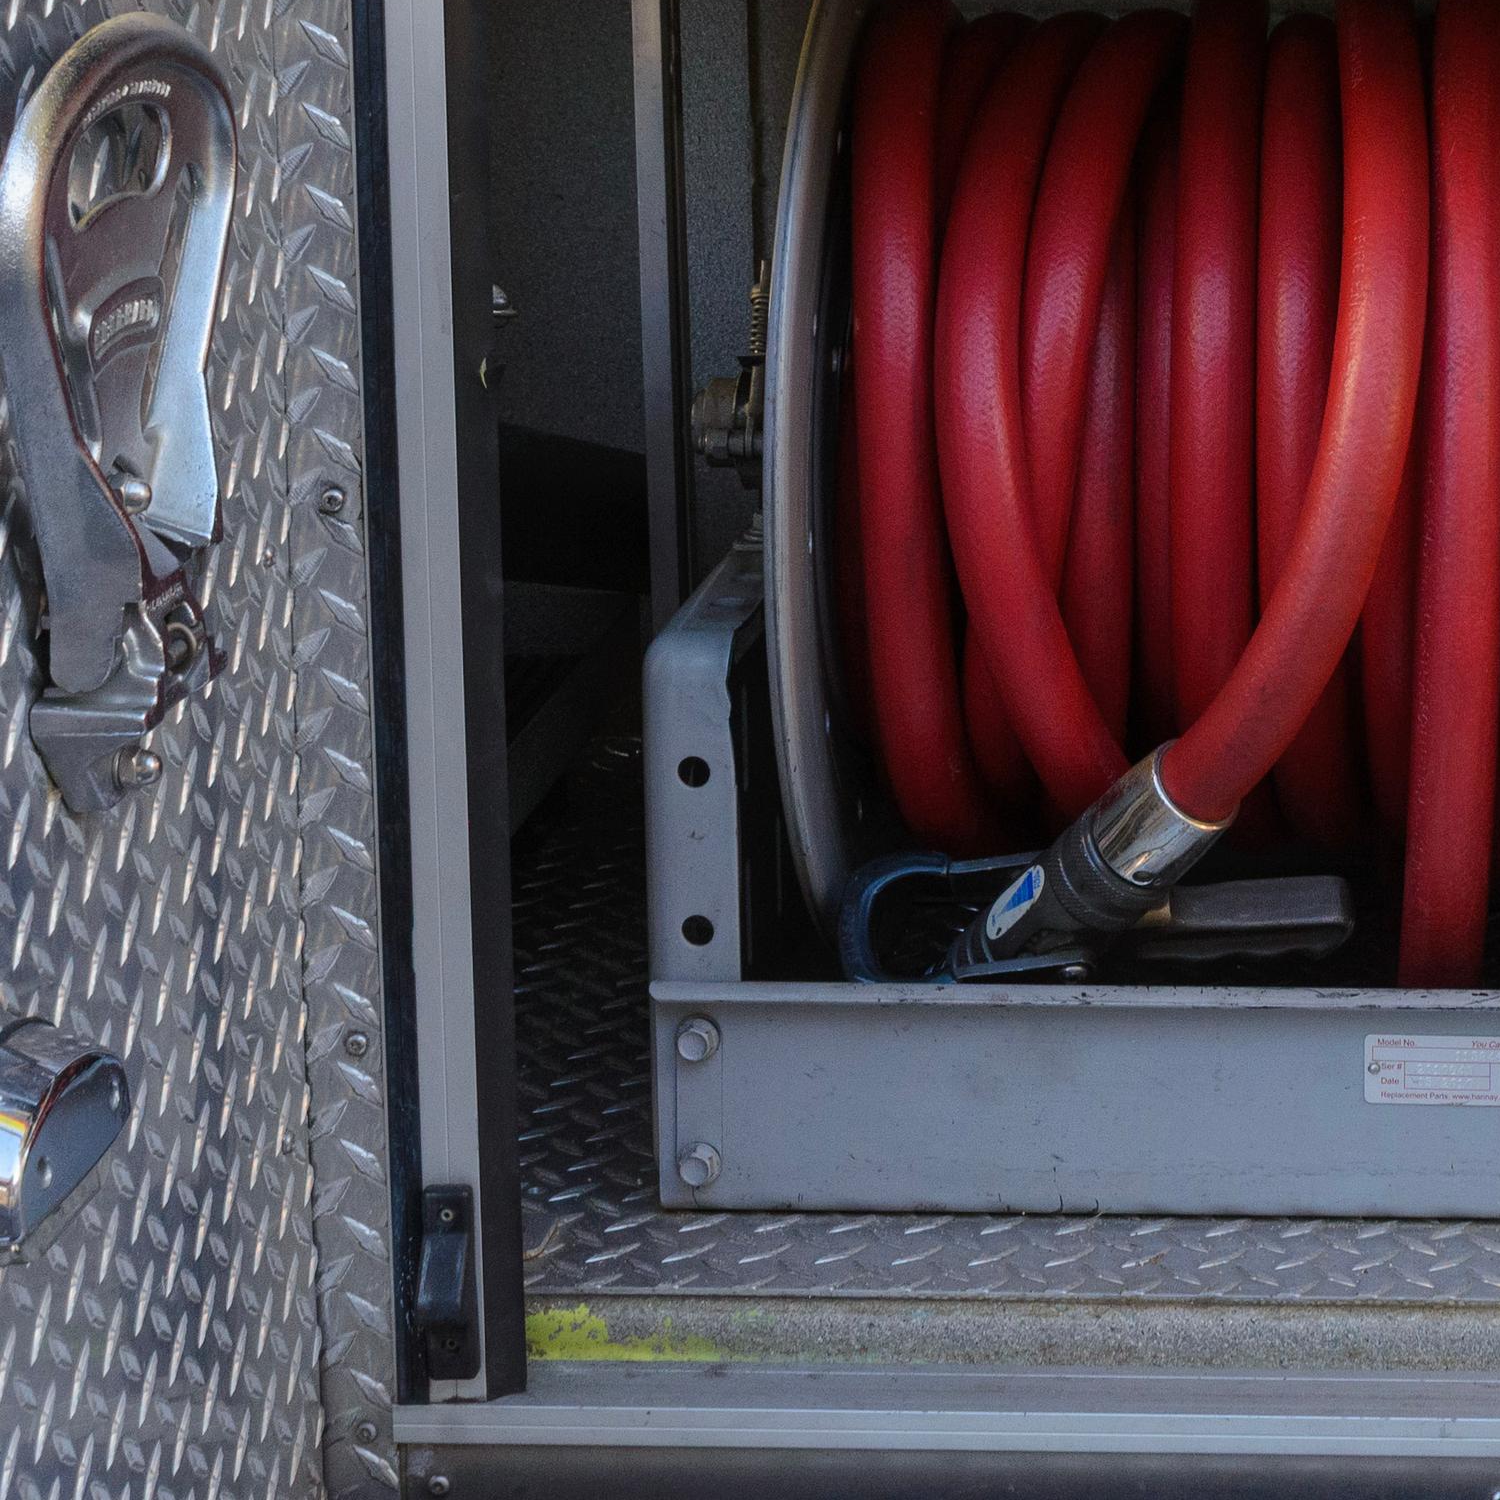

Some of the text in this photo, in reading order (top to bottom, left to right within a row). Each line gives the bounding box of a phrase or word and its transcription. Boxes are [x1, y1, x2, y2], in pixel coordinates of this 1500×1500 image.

[1377, 1038, 1402, 1046] Model
[1471, 1040, 1487, 1048] You
[1380, 1077, 1400, 1085] Date
[1380, 1091, 1428, 1100] Replacement
